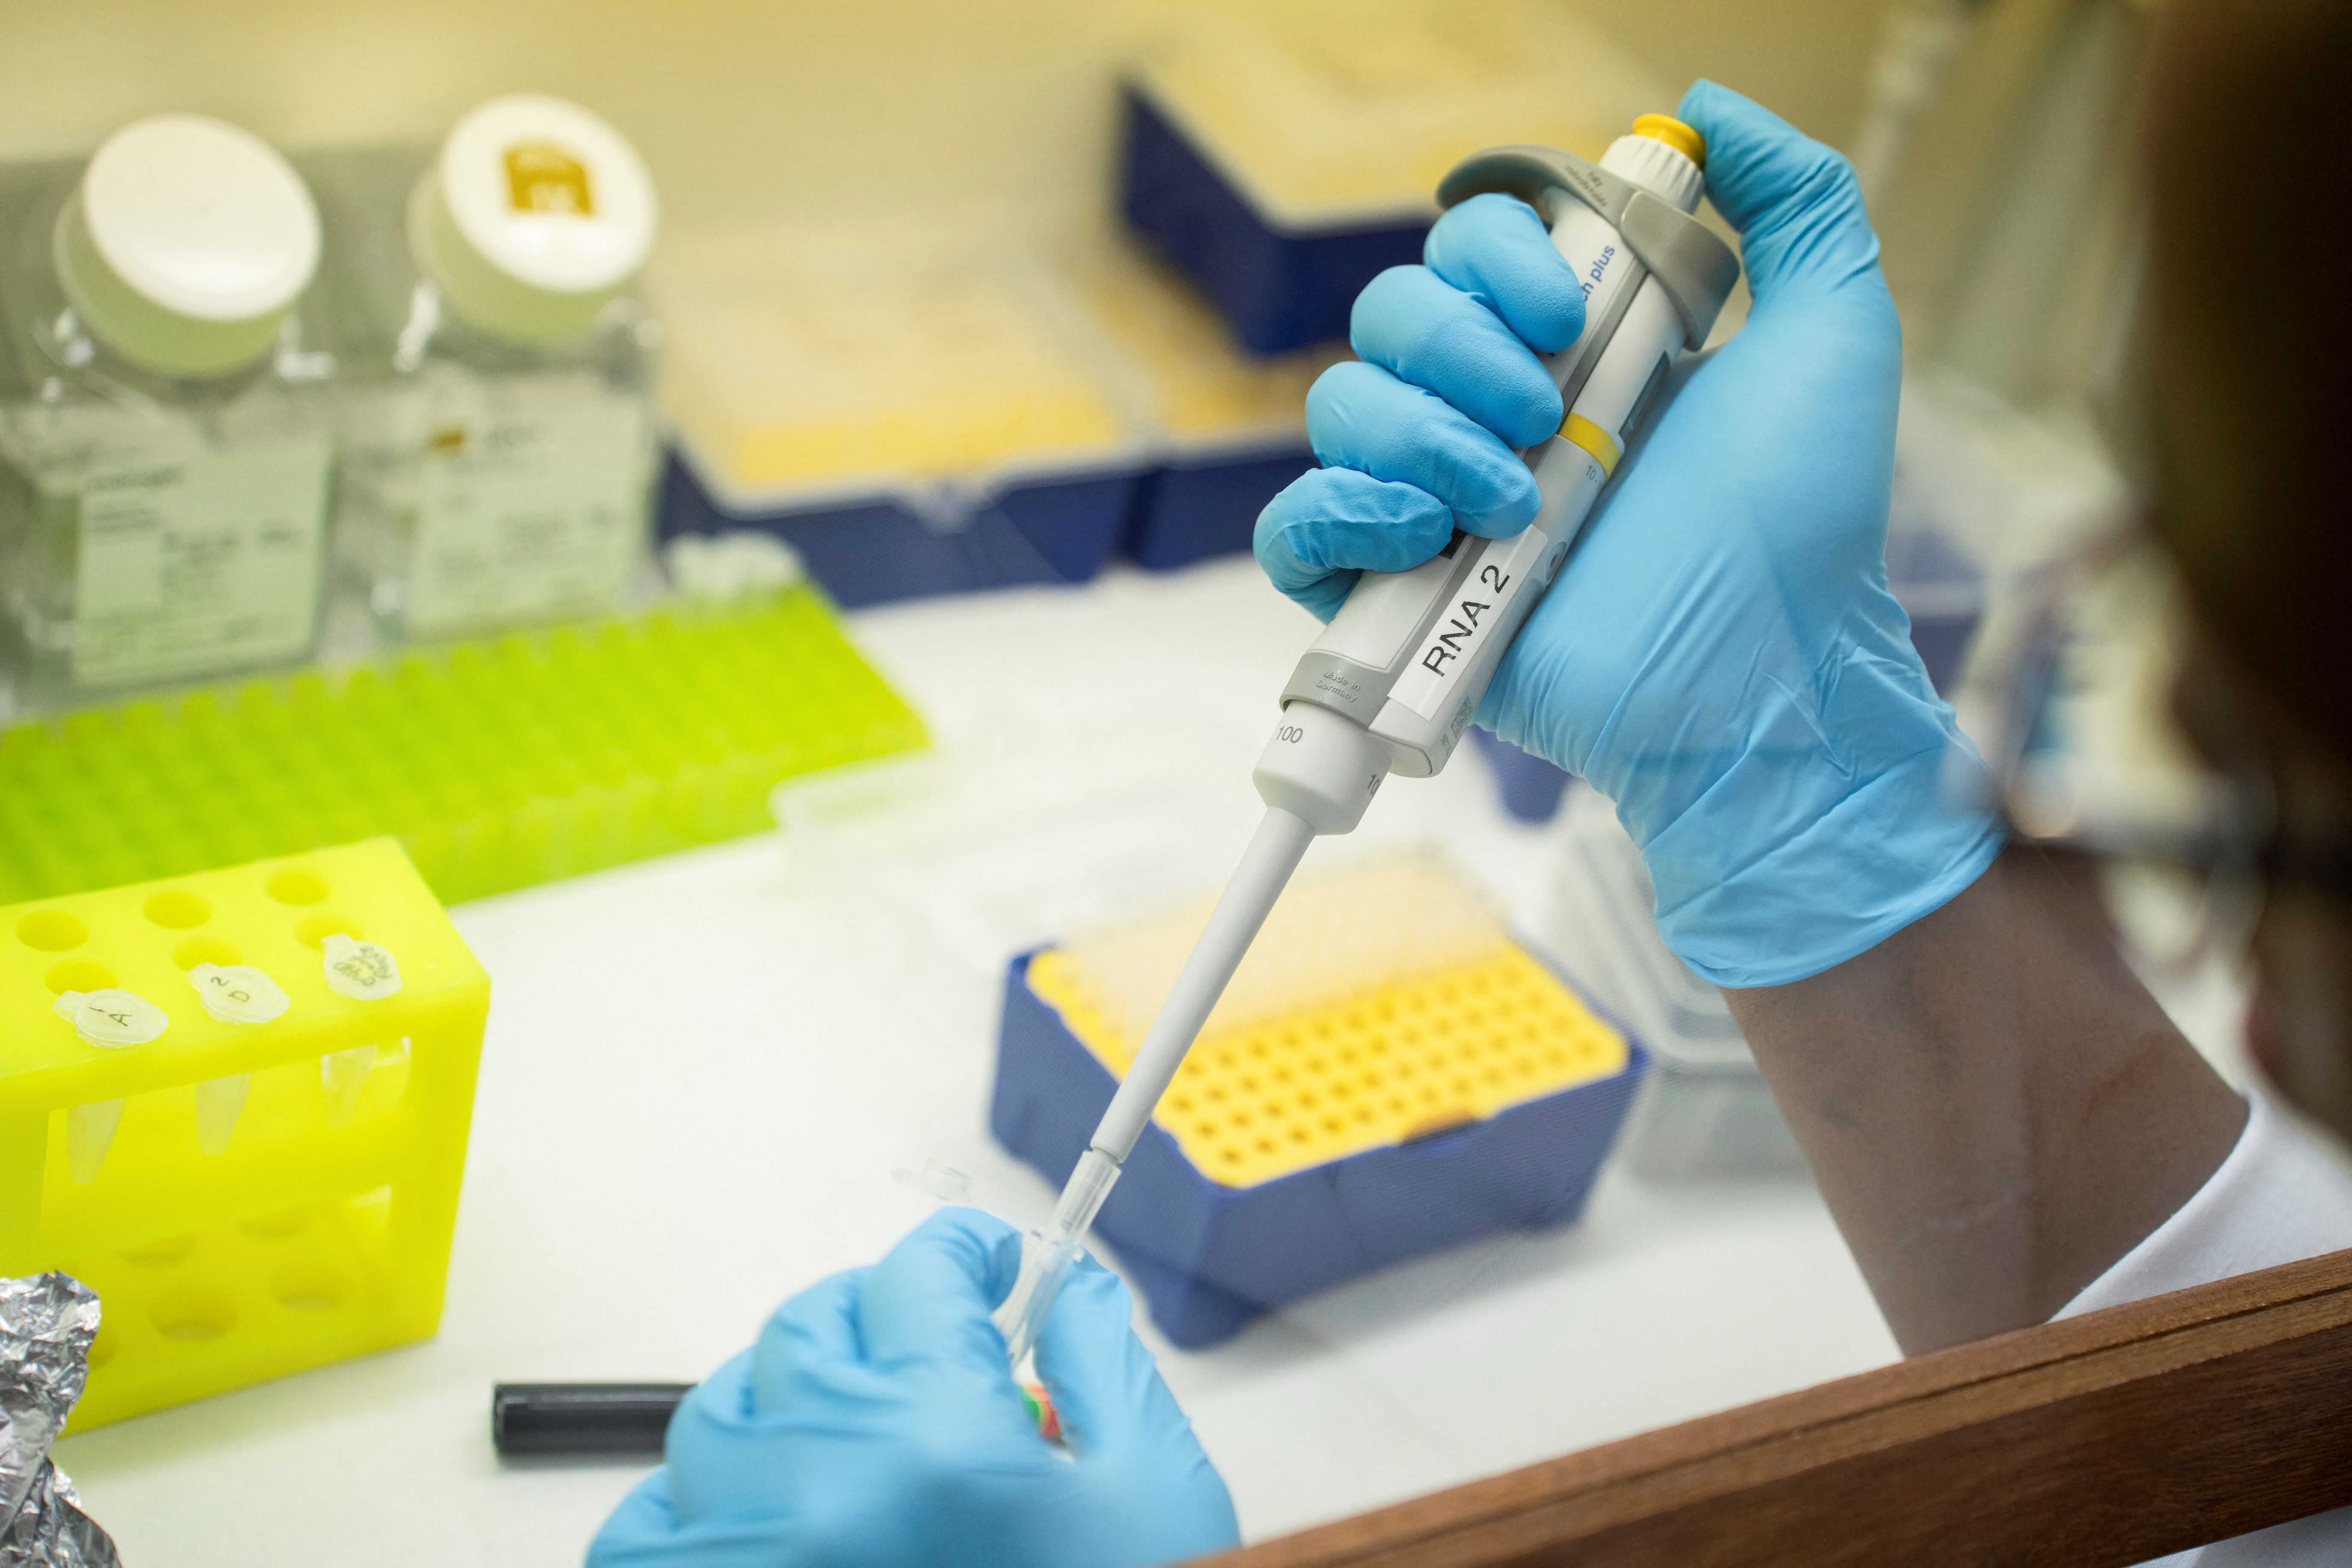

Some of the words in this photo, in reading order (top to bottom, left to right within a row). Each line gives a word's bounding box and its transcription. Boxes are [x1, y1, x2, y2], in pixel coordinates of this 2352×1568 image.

[1590, 245, 1615, 283] plus
[1422, 601, 1491, 677] RNA
[1480, 565, 1510, 594] 2
[1316, 680, 1358, 703] Germany
[1324, 671, 1348, 685] Made
[1351, 681, 1360, 691] in
[1276, 725, 1303, 743] 100
[1368, 774, 1381, 796] 10
[228, 990, 249, 1002] D
[108, 1013, 133, 1027] A
